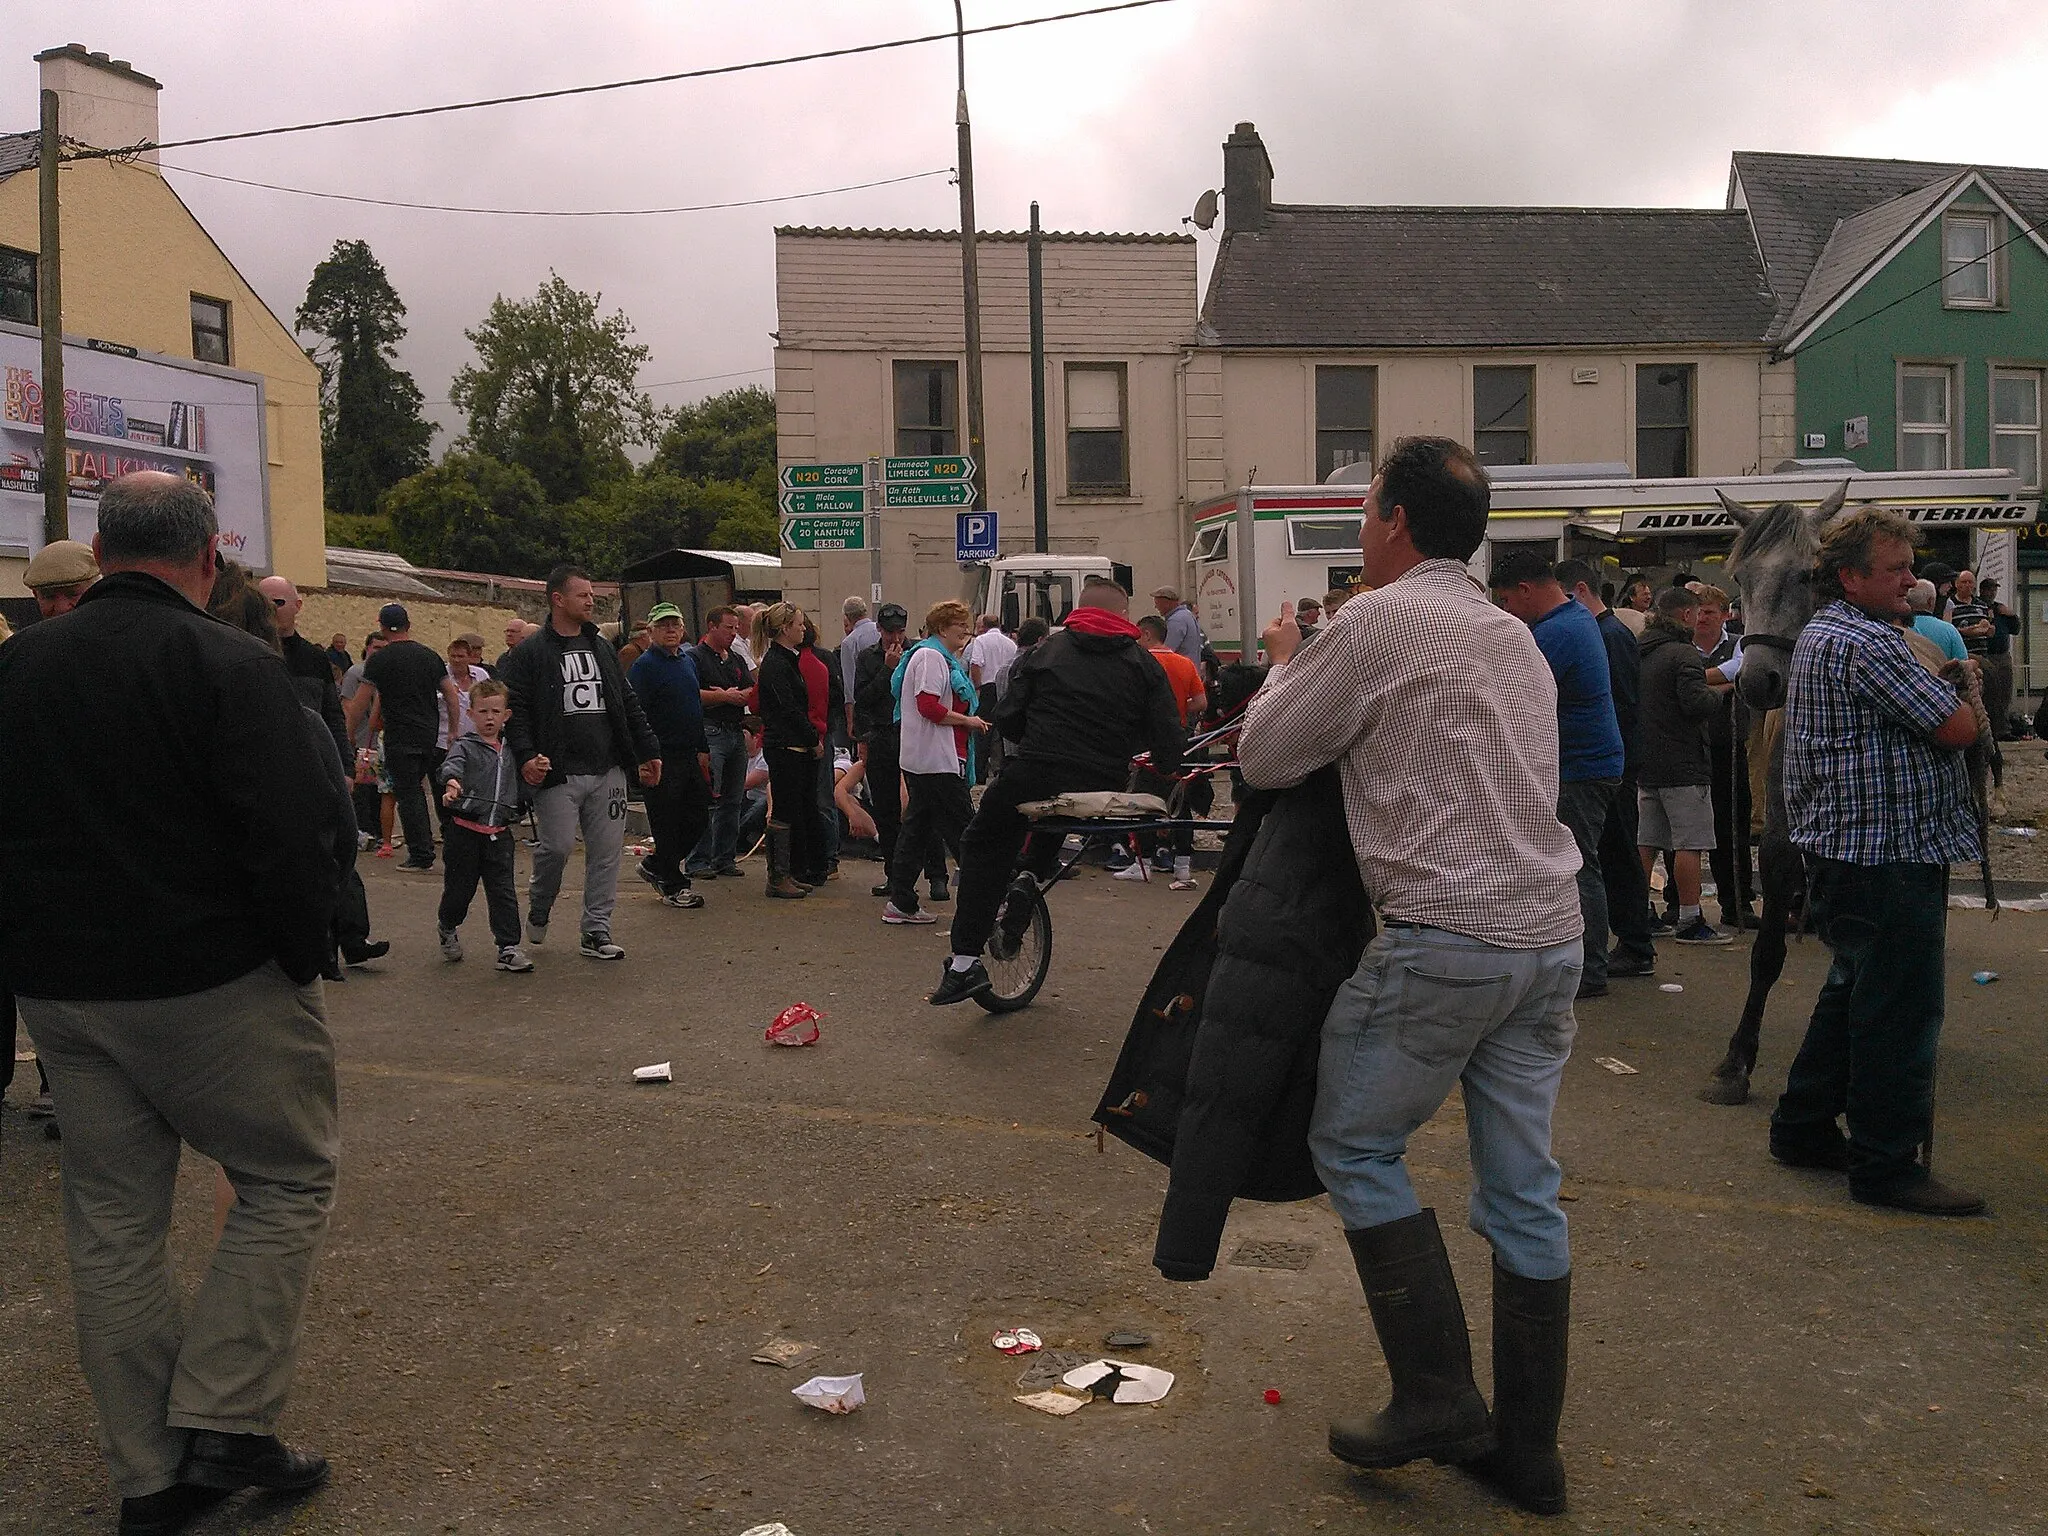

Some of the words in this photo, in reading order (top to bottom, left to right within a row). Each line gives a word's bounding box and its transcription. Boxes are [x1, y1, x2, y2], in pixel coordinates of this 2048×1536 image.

[5, 366, 32, 381] THE
[6, 379, 43, 405] BO
[64, 389, 122, 420] SETS
[5, 401, 124, 438] EVEONE'S
[823, 467, 859, 476] Corcaigh
[888, 469, 930, 478] LIMERICK
[934, 464, 958, 474] N20
[796, 472, 820, 482] N20
[824, 476, 849, 484] CORK
[1, 479, 36, 492] NASHVILLE
[889, 495, 947, 504] CHARLEVILLE
[950, 494, 960, 502] 14
[796, 502, 806, 511] 12
[816, 502, 853, 510] MALLOW
[1637, 513, 1734, 528] ADVA
[1891, 506, 2027, 522] TERING
[799, 529, 811, 537] 20
[814, 528, 855, 537] KANTURK
[968, 518, 985, 543] P
[222, 530, 247, 551] sky
[958, 549, 995, 559] PARKING
[1344, 574, 1362, 584] Ad
[608, 800, 627, 820] 09
